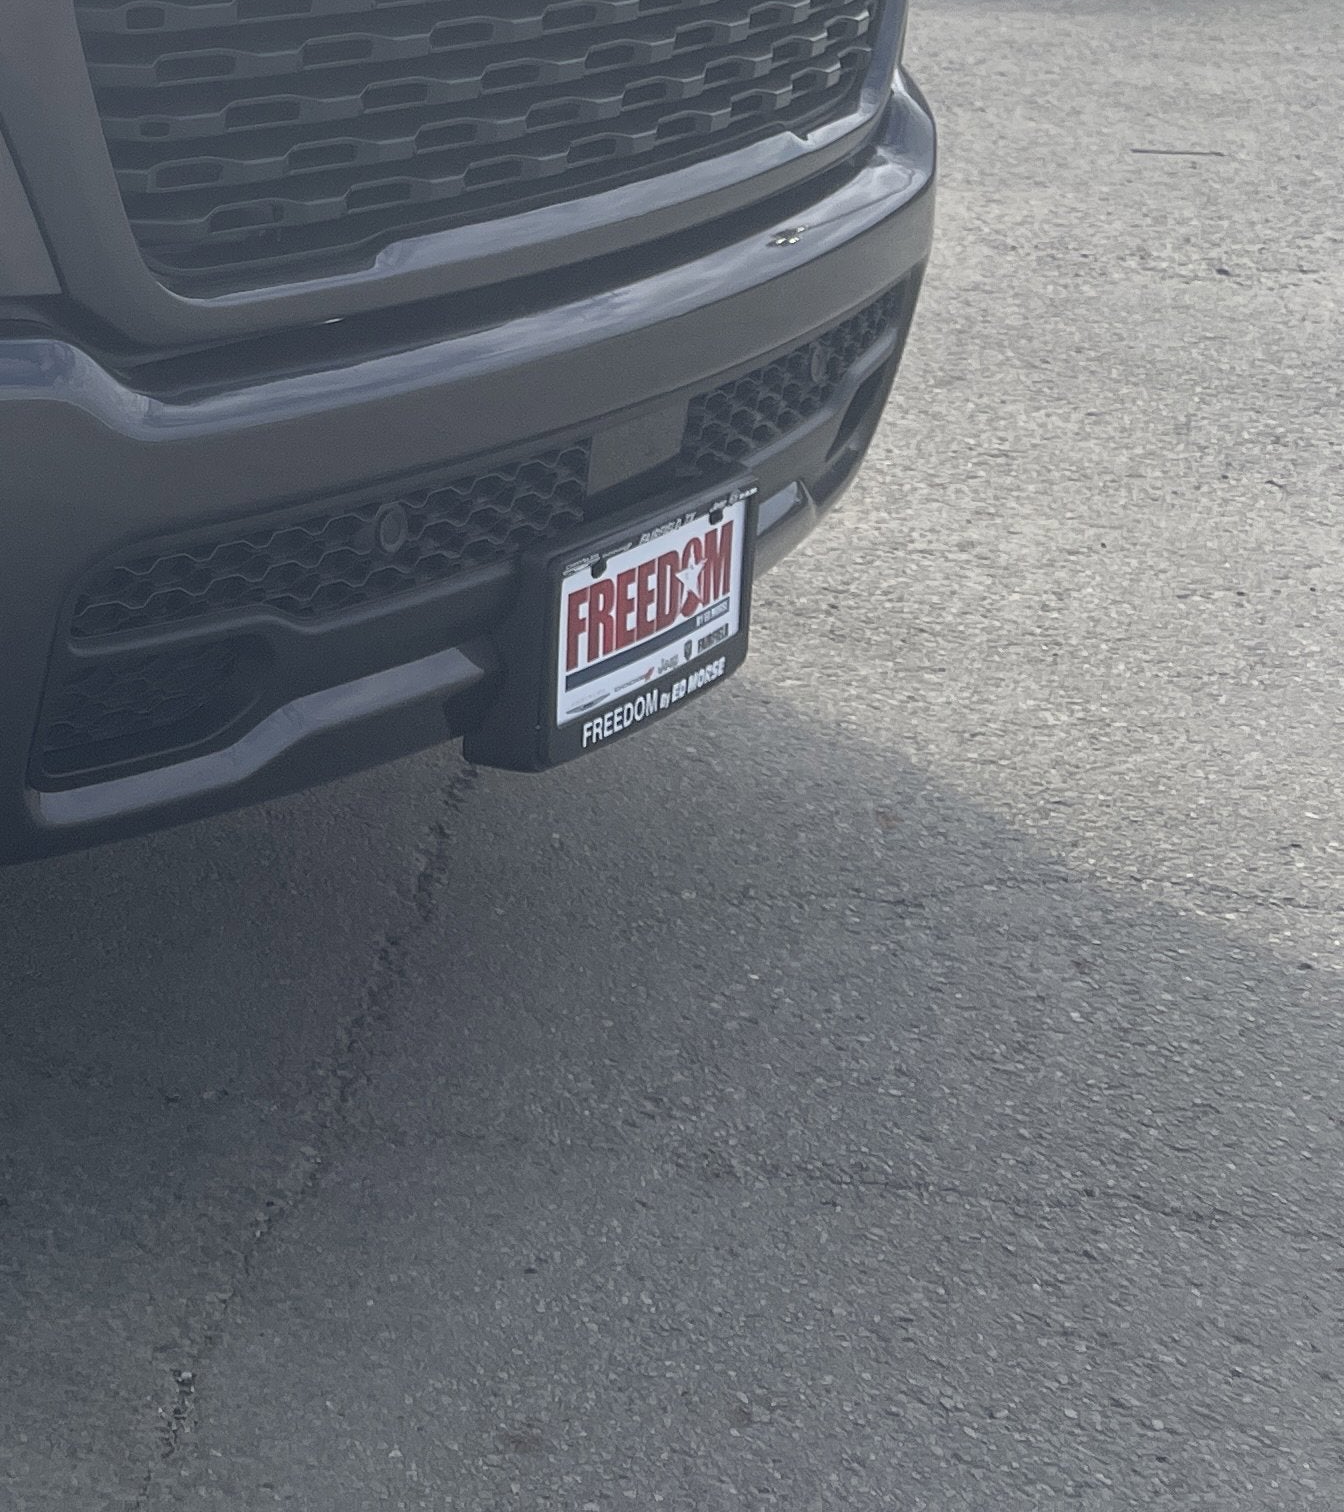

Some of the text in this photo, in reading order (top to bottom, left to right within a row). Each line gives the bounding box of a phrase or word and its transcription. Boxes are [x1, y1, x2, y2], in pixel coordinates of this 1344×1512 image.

[566, 519, 734, 672] FREEDOM
[581, 688, 659, 749] FREEDOM
[672, 678, 688, 703] ED
[687, 656, 726, 694] MORSE
